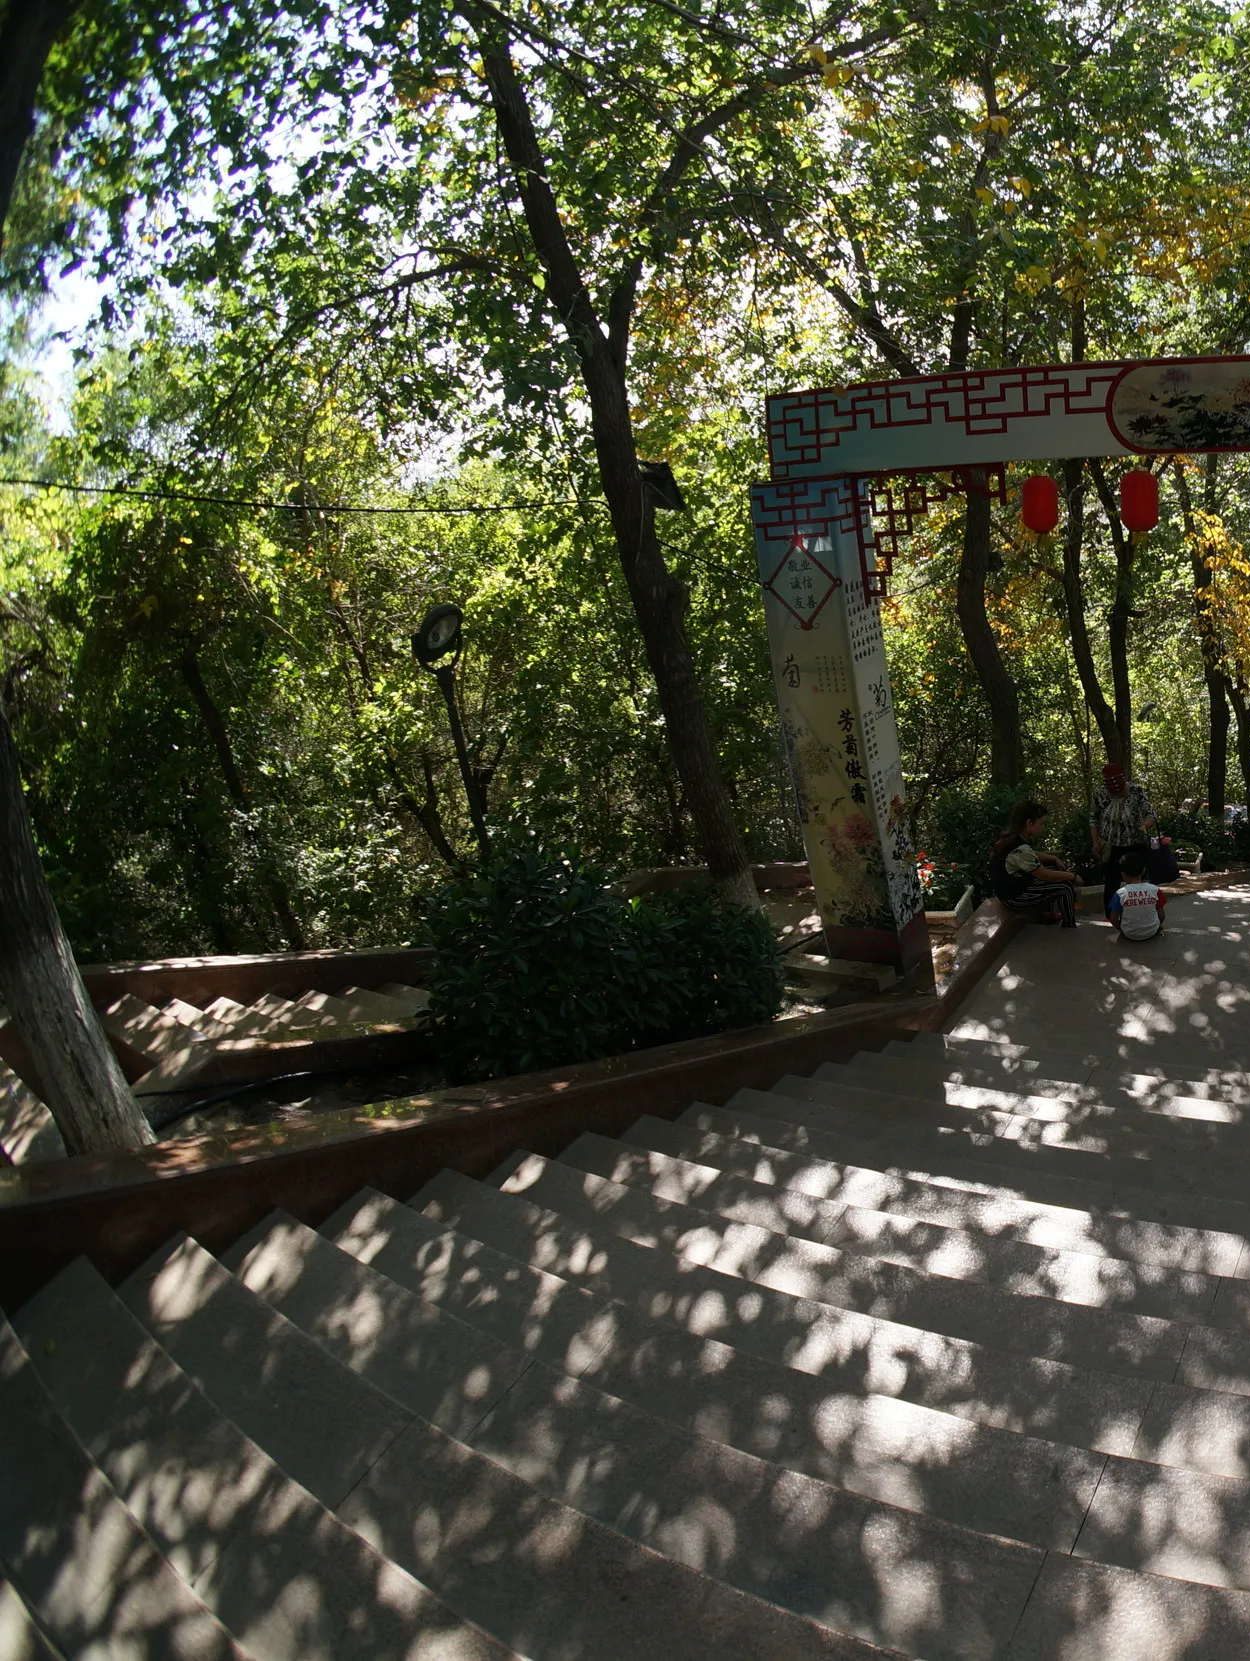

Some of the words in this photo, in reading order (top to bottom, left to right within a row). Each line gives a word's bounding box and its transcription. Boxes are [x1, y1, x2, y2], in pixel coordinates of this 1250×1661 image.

[788, 559, 812, 572] 敬业
[789, 577, 813, 591] 诚信
[793, 595, 818, 609] 友善
